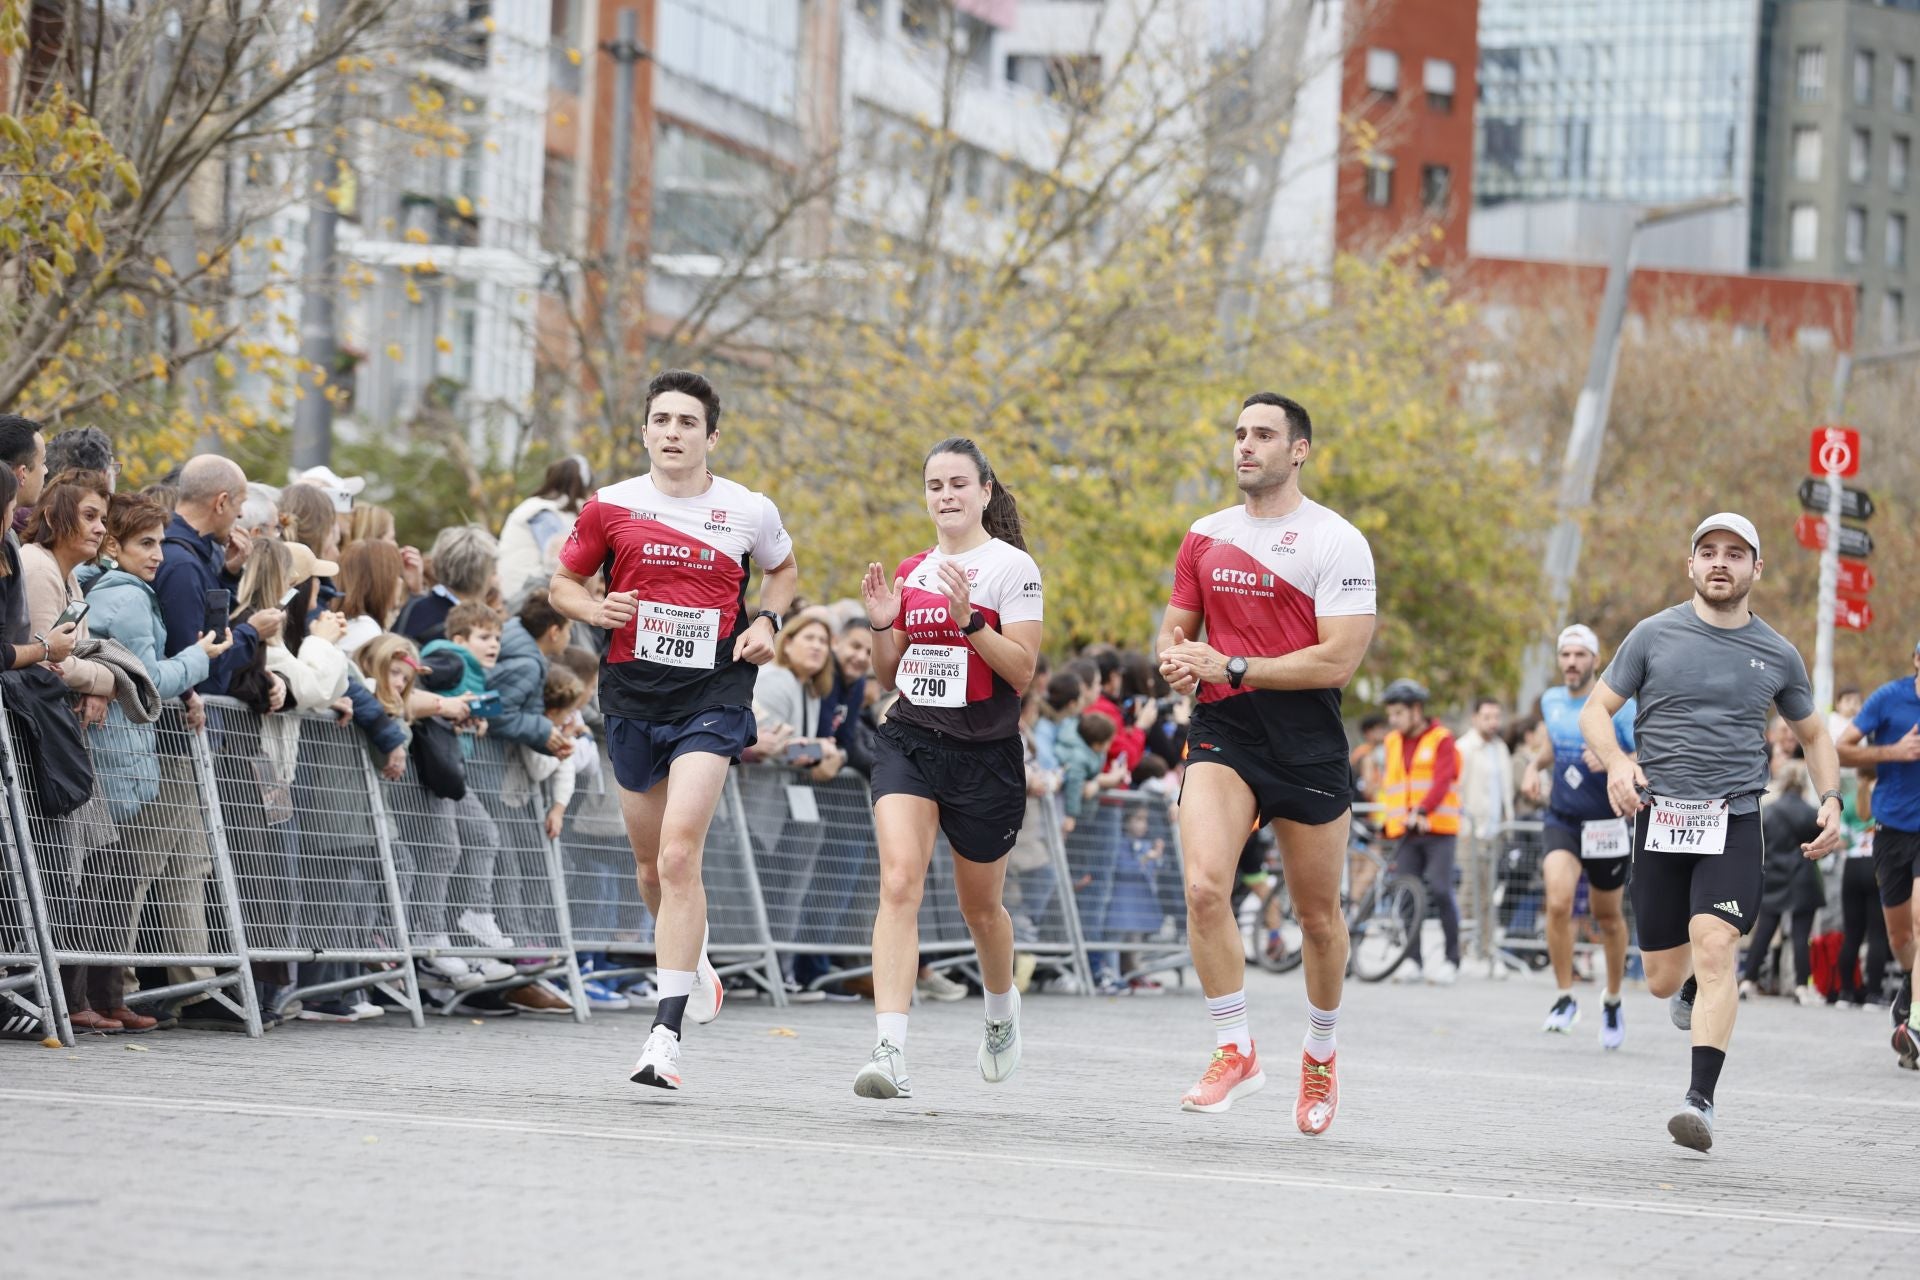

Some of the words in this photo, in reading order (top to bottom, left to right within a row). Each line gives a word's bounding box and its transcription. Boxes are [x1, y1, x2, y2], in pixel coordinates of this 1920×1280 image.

[704, 522, 731, 533] Getxo
[642, 543, 691, 558] GETXO
[1271, 544, 1296, 555] Getxo
[1212, 567, 1257, 586] GETXO
[654, 606, 664, 614] EL
[665, 608, 702, 619] CORREO
[643, 617, 674, 635] XXXVI
[677, 623, 710, 632] SANTURCE
[676, 630, 710, 639] BILBAO
[641, 645, 648, 659] k
[655, 636, 694, 658] 2789
[921, 649, 950, 657] CORREO
[902, 660, 927, 675] XXXVI
[929, 662, 960, 670] SANTURCE
[928, 669, 959, 677] BILBAO
[911, 677, 946, 697] 2790
[1665, 800, 1674, 808] EL
[1675, 802, 1709, 810] CORREO
[1655, 811, 1684, 827] XXXVI
[1669, 829, 1705, 845] 1747
[1652, 839, 1660, 850] k
[1713, 903, 1743, 918] adidas
